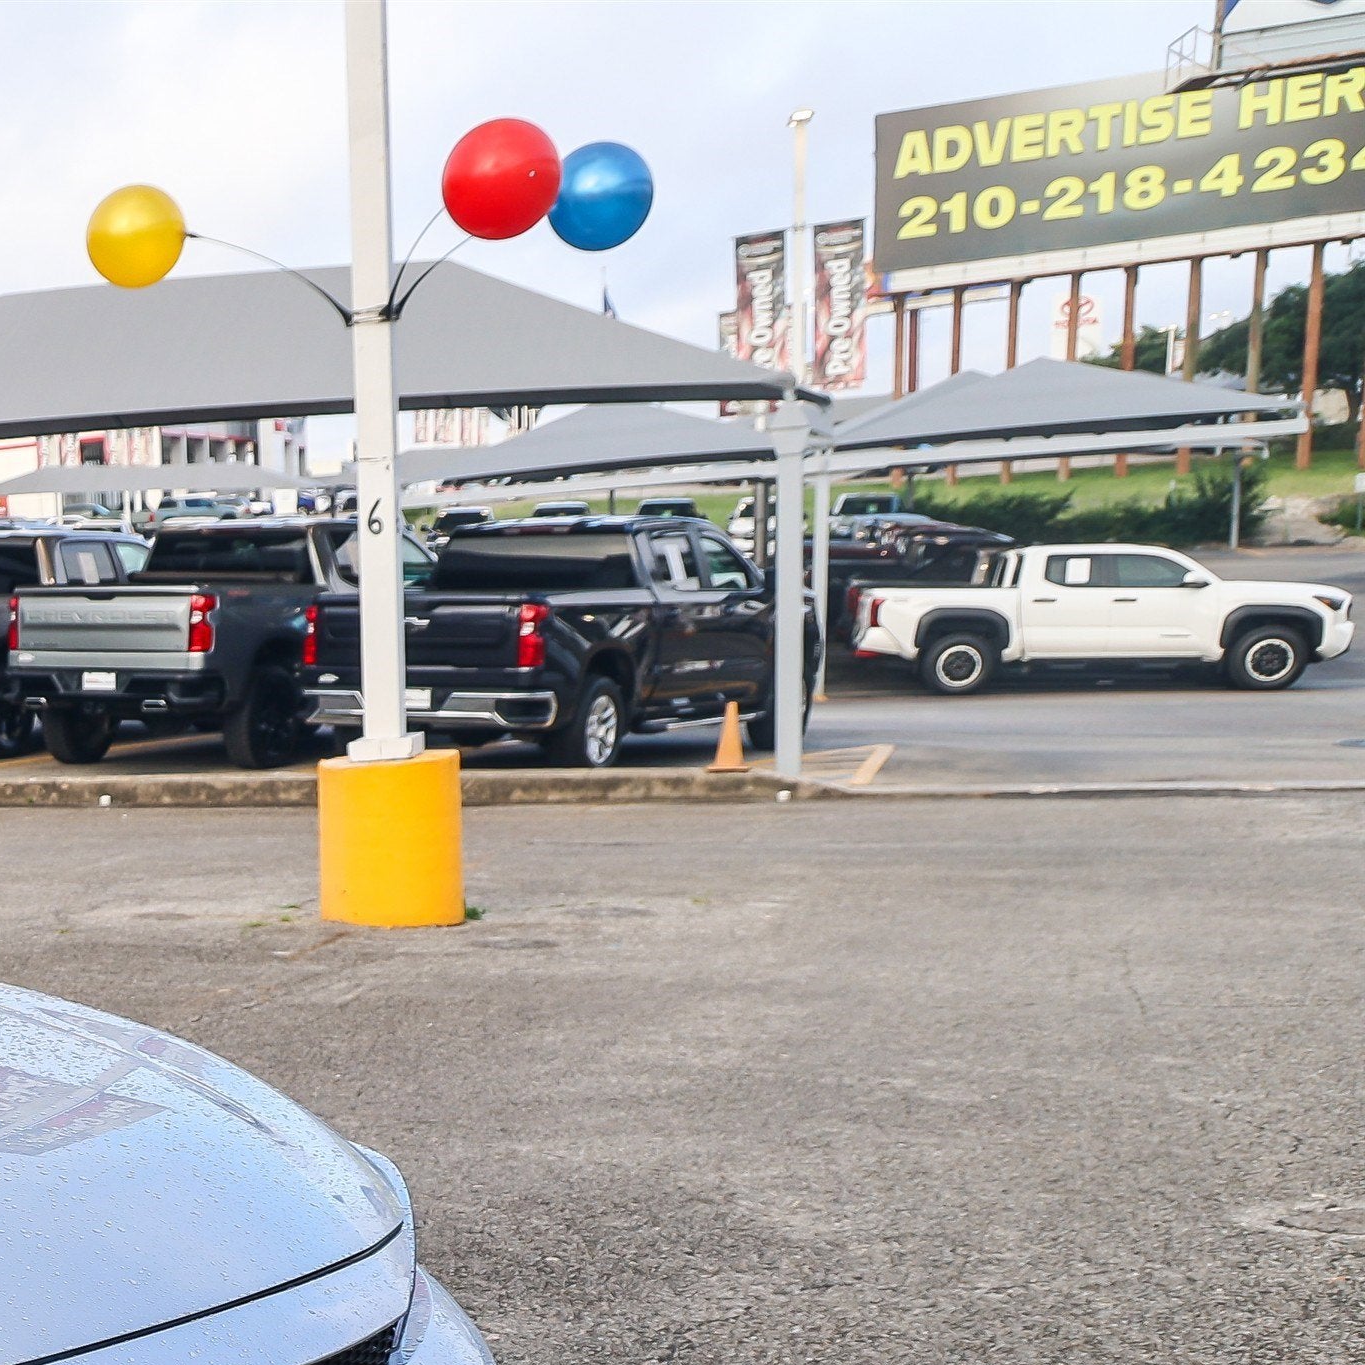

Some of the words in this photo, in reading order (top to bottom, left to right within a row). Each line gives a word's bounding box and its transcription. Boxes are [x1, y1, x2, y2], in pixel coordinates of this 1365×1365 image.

[892, 88, 1214, 180] ADVERTISE
[746, 268, 773, 347] Owned
[824, 257, 852, 337] Owned
[824, 338, 852, 376] Pre
[368, 497, 382, 535] 6
[26, 610, 173, 624] CHEVROLET
